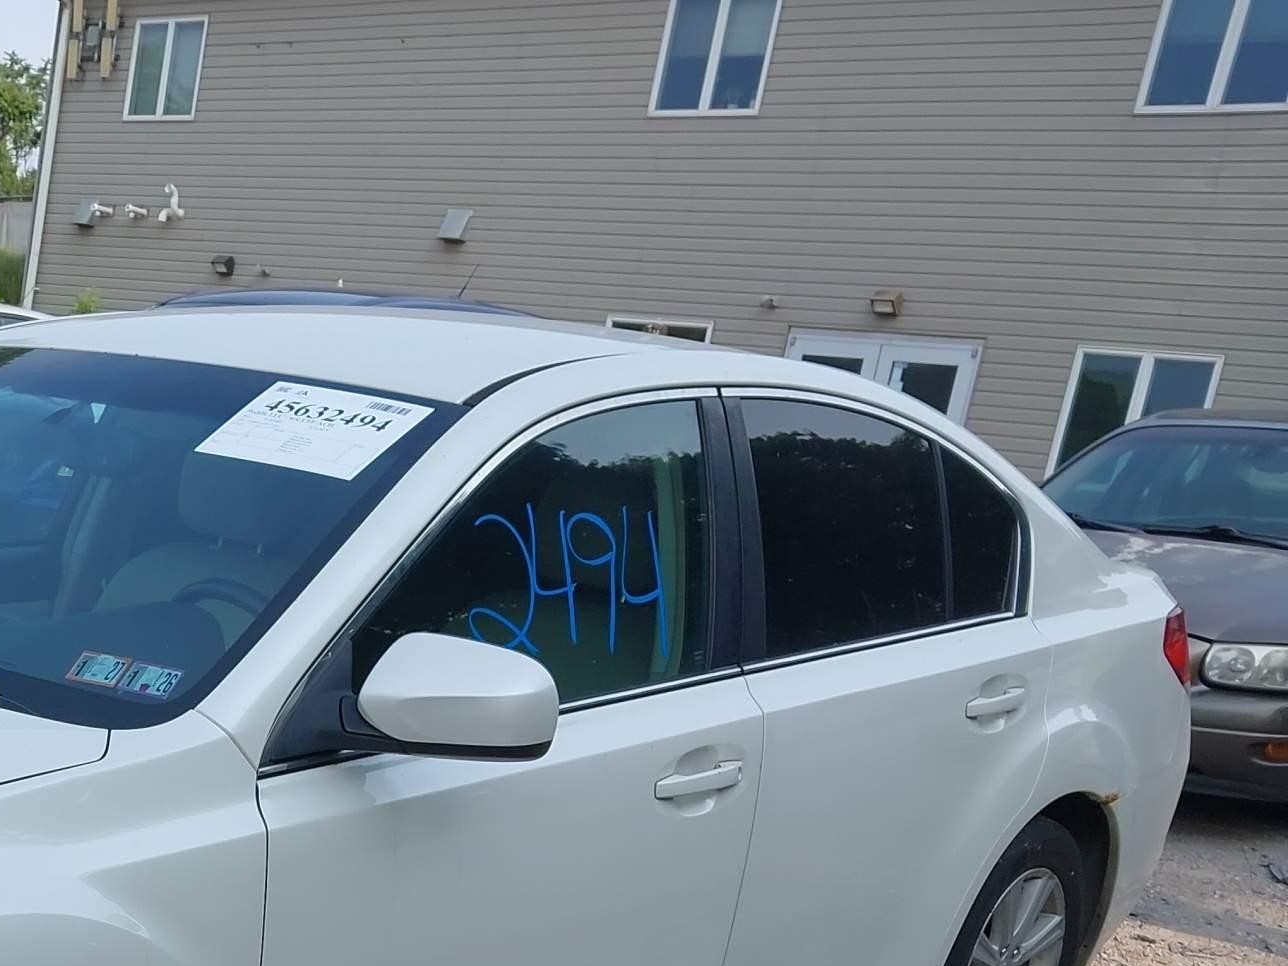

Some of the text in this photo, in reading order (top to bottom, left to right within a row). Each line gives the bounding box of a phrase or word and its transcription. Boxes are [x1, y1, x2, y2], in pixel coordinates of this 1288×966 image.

[263, 398, 394, 433] 45632494
[469, 502, 669, 659] 2494
[104, 661, 127, 682] 27
[156, 672, 178, 694] 26
